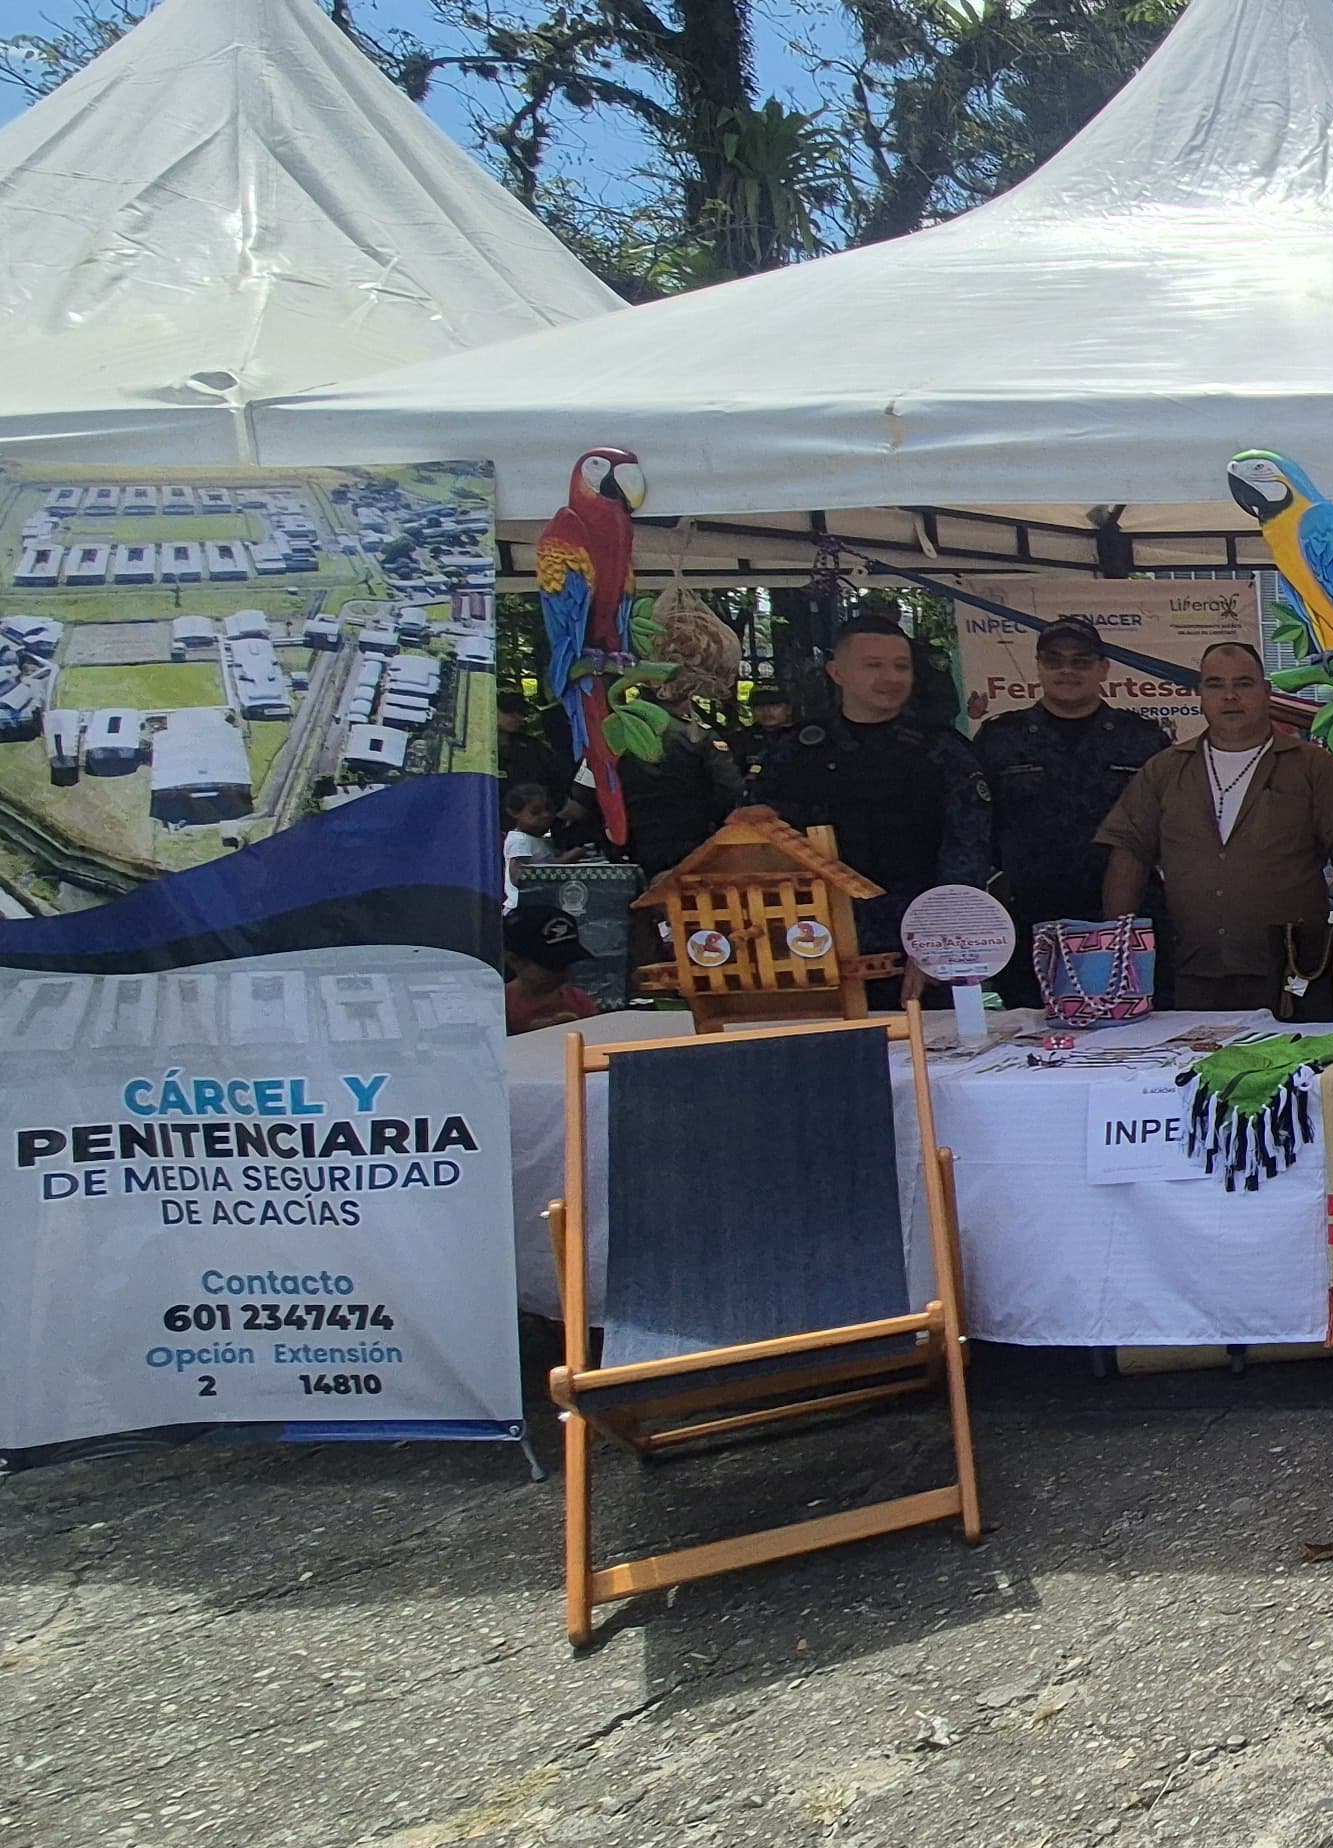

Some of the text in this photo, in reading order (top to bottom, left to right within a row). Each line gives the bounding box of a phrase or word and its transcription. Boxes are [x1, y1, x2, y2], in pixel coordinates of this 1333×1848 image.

[987, 676, 1043, 700] Fer
[1139, 703, 1204, 717] PROPÓS
[946, 936, 1008, 948] Artesanal
[122, 1069, 390, 1117] CÁRCEL Y
[16, 1115, 479, 1168] PENITENCIARIA
[1104, 1117, 1182, 1146] INPE
[42, 1160, 461, 1201] DE MEDIA SEGURIDAD
[161, 1193, 360, 1226] DE ACACÍAS
[201, 1269, 355, 1297] Contacto
[163, 1303, 395, 1333] 601 2347474
[145, 1340, 403, 1373] Opción Extensión
[197, 1373, 383, 1397] 2 14810
